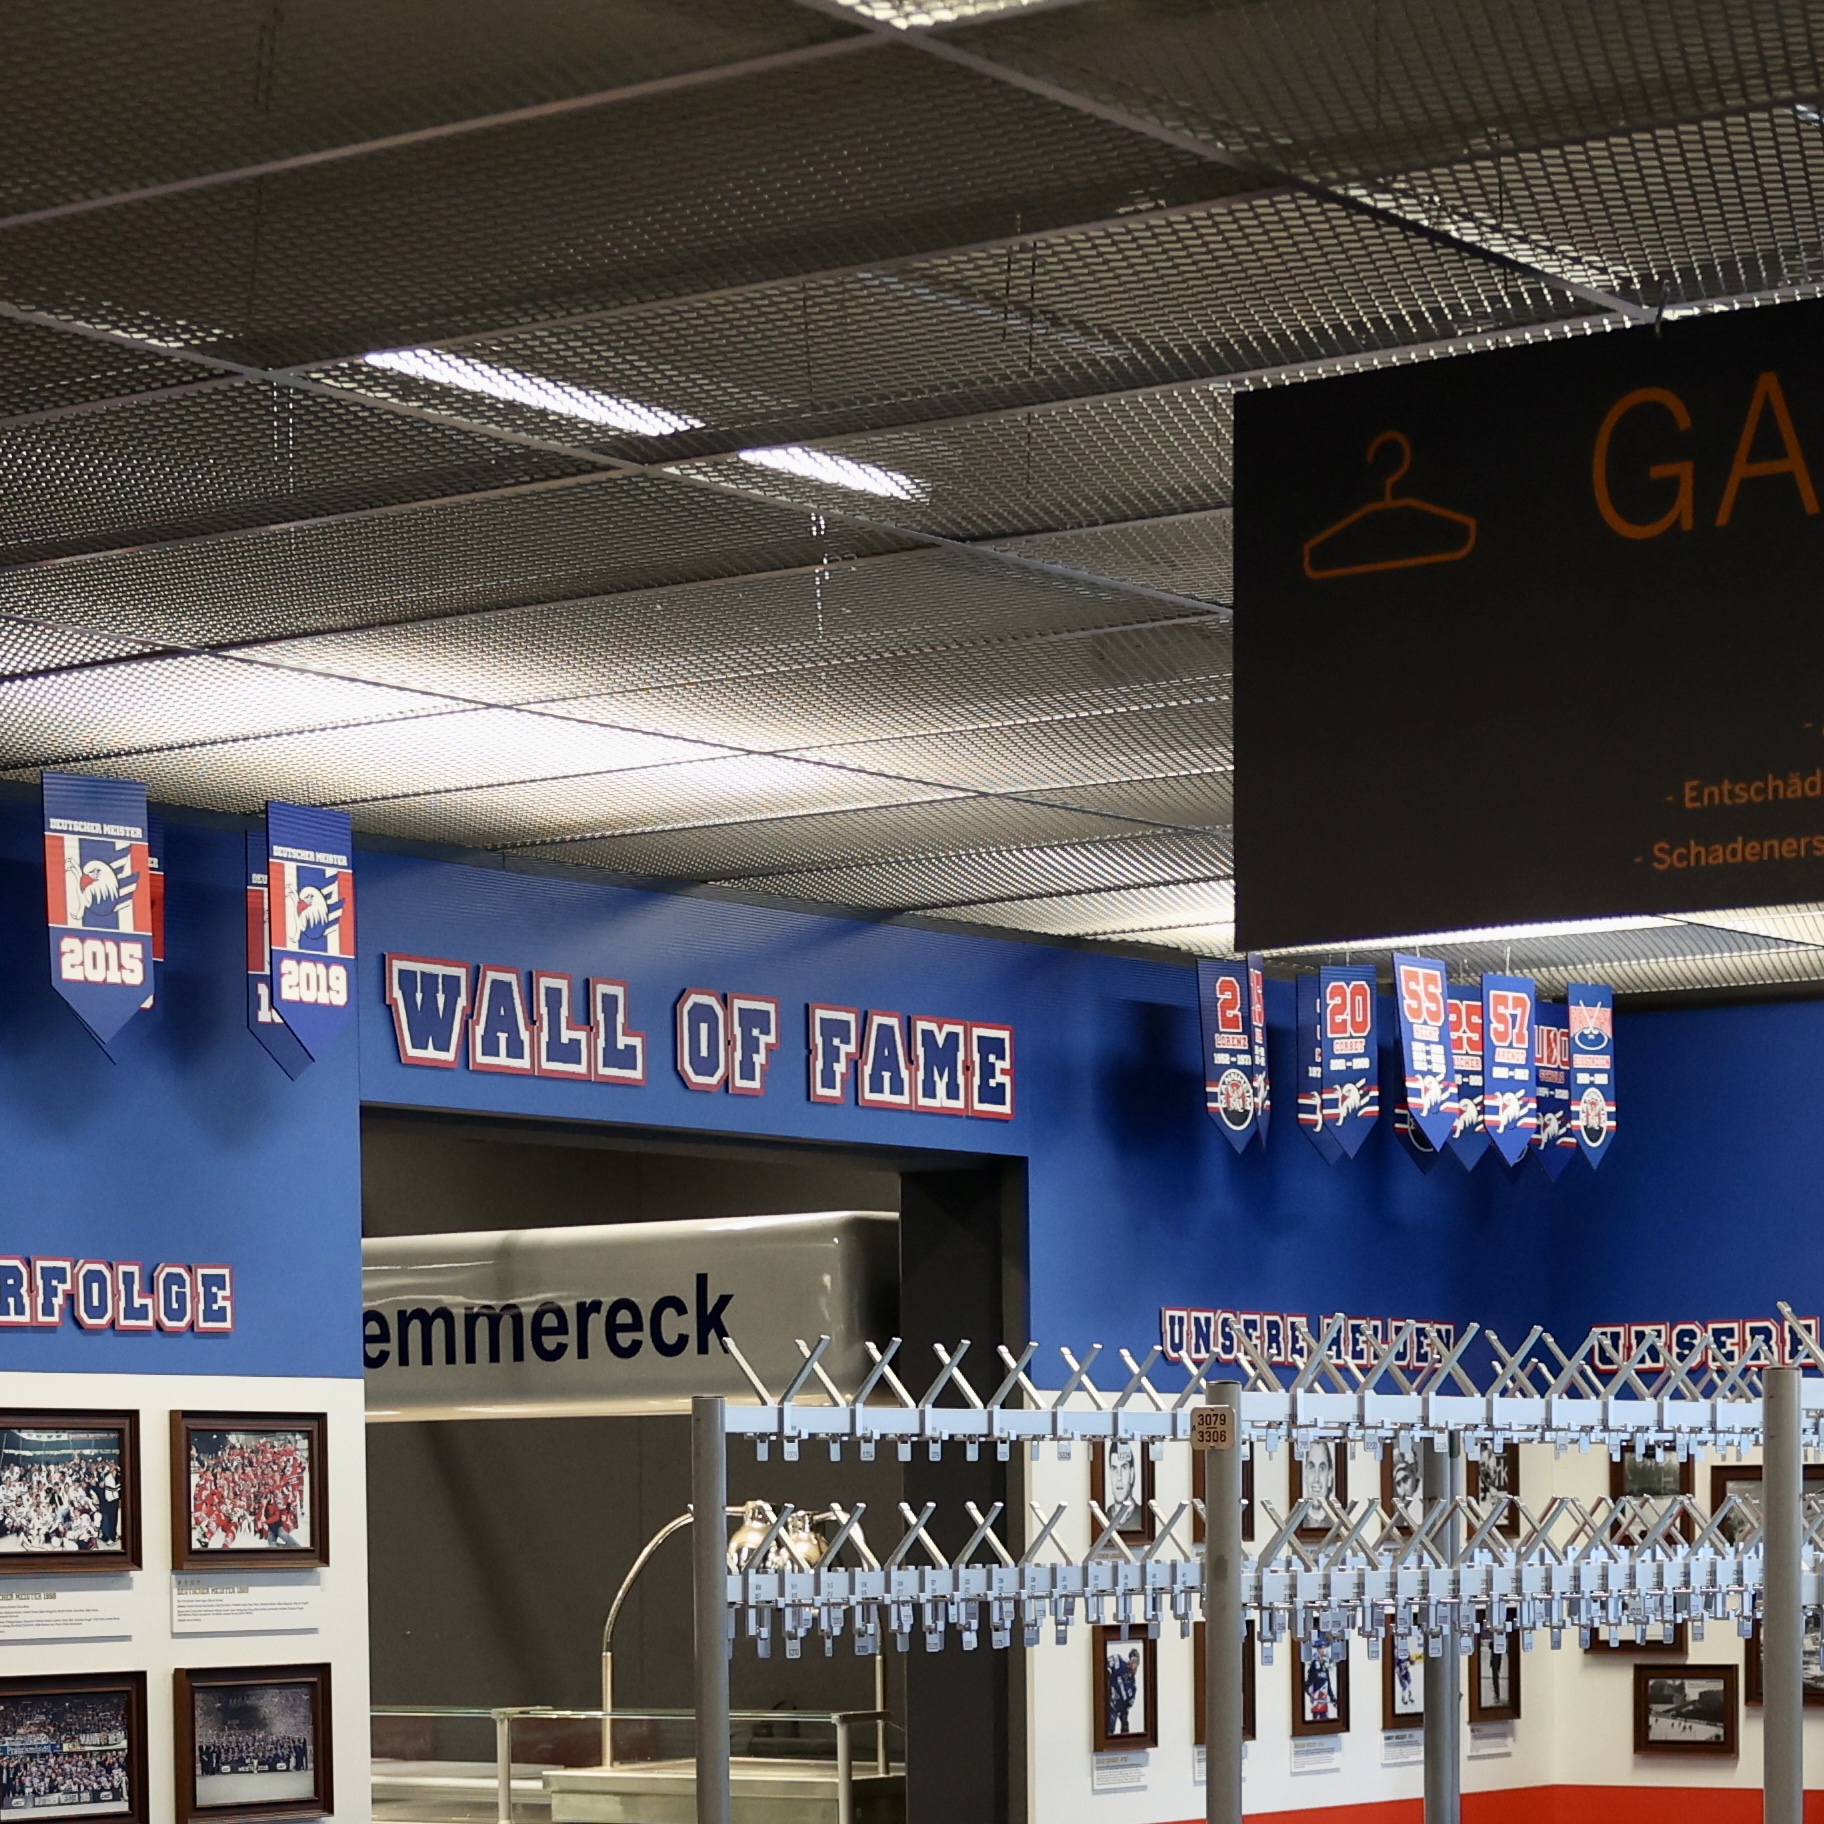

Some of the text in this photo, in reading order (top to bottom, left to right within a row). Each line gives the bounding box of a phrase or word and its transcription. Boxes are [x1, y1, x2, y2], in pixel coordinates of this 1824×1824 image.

[49, 818, 143, 839] DEUTSCHER MEISTER
[59, 935, 145, 987] 2015
[280, 957, 350, 1007] 2019
[1215, 975, 1243, 1033] 2
[1326, 980, 1371, 1038] 20
[1399, 964, 1445, 1027] 55
[1489, 989, 1531, 1049] 57
[384, 952, 1015, 1121] WALL OF FAME
[1214, 1033, 1249, 1050] LORENZ
[363, 1273, 735, 1368] emmereck
[1161, 1306, 1456, 1371] UNSERE HELDEN
[1591, 1316, 1821, 1373] UNSERE
[1197, 1413, 1227, 1426] 3079
[1197, 1430, 1227, 1443] 3306
